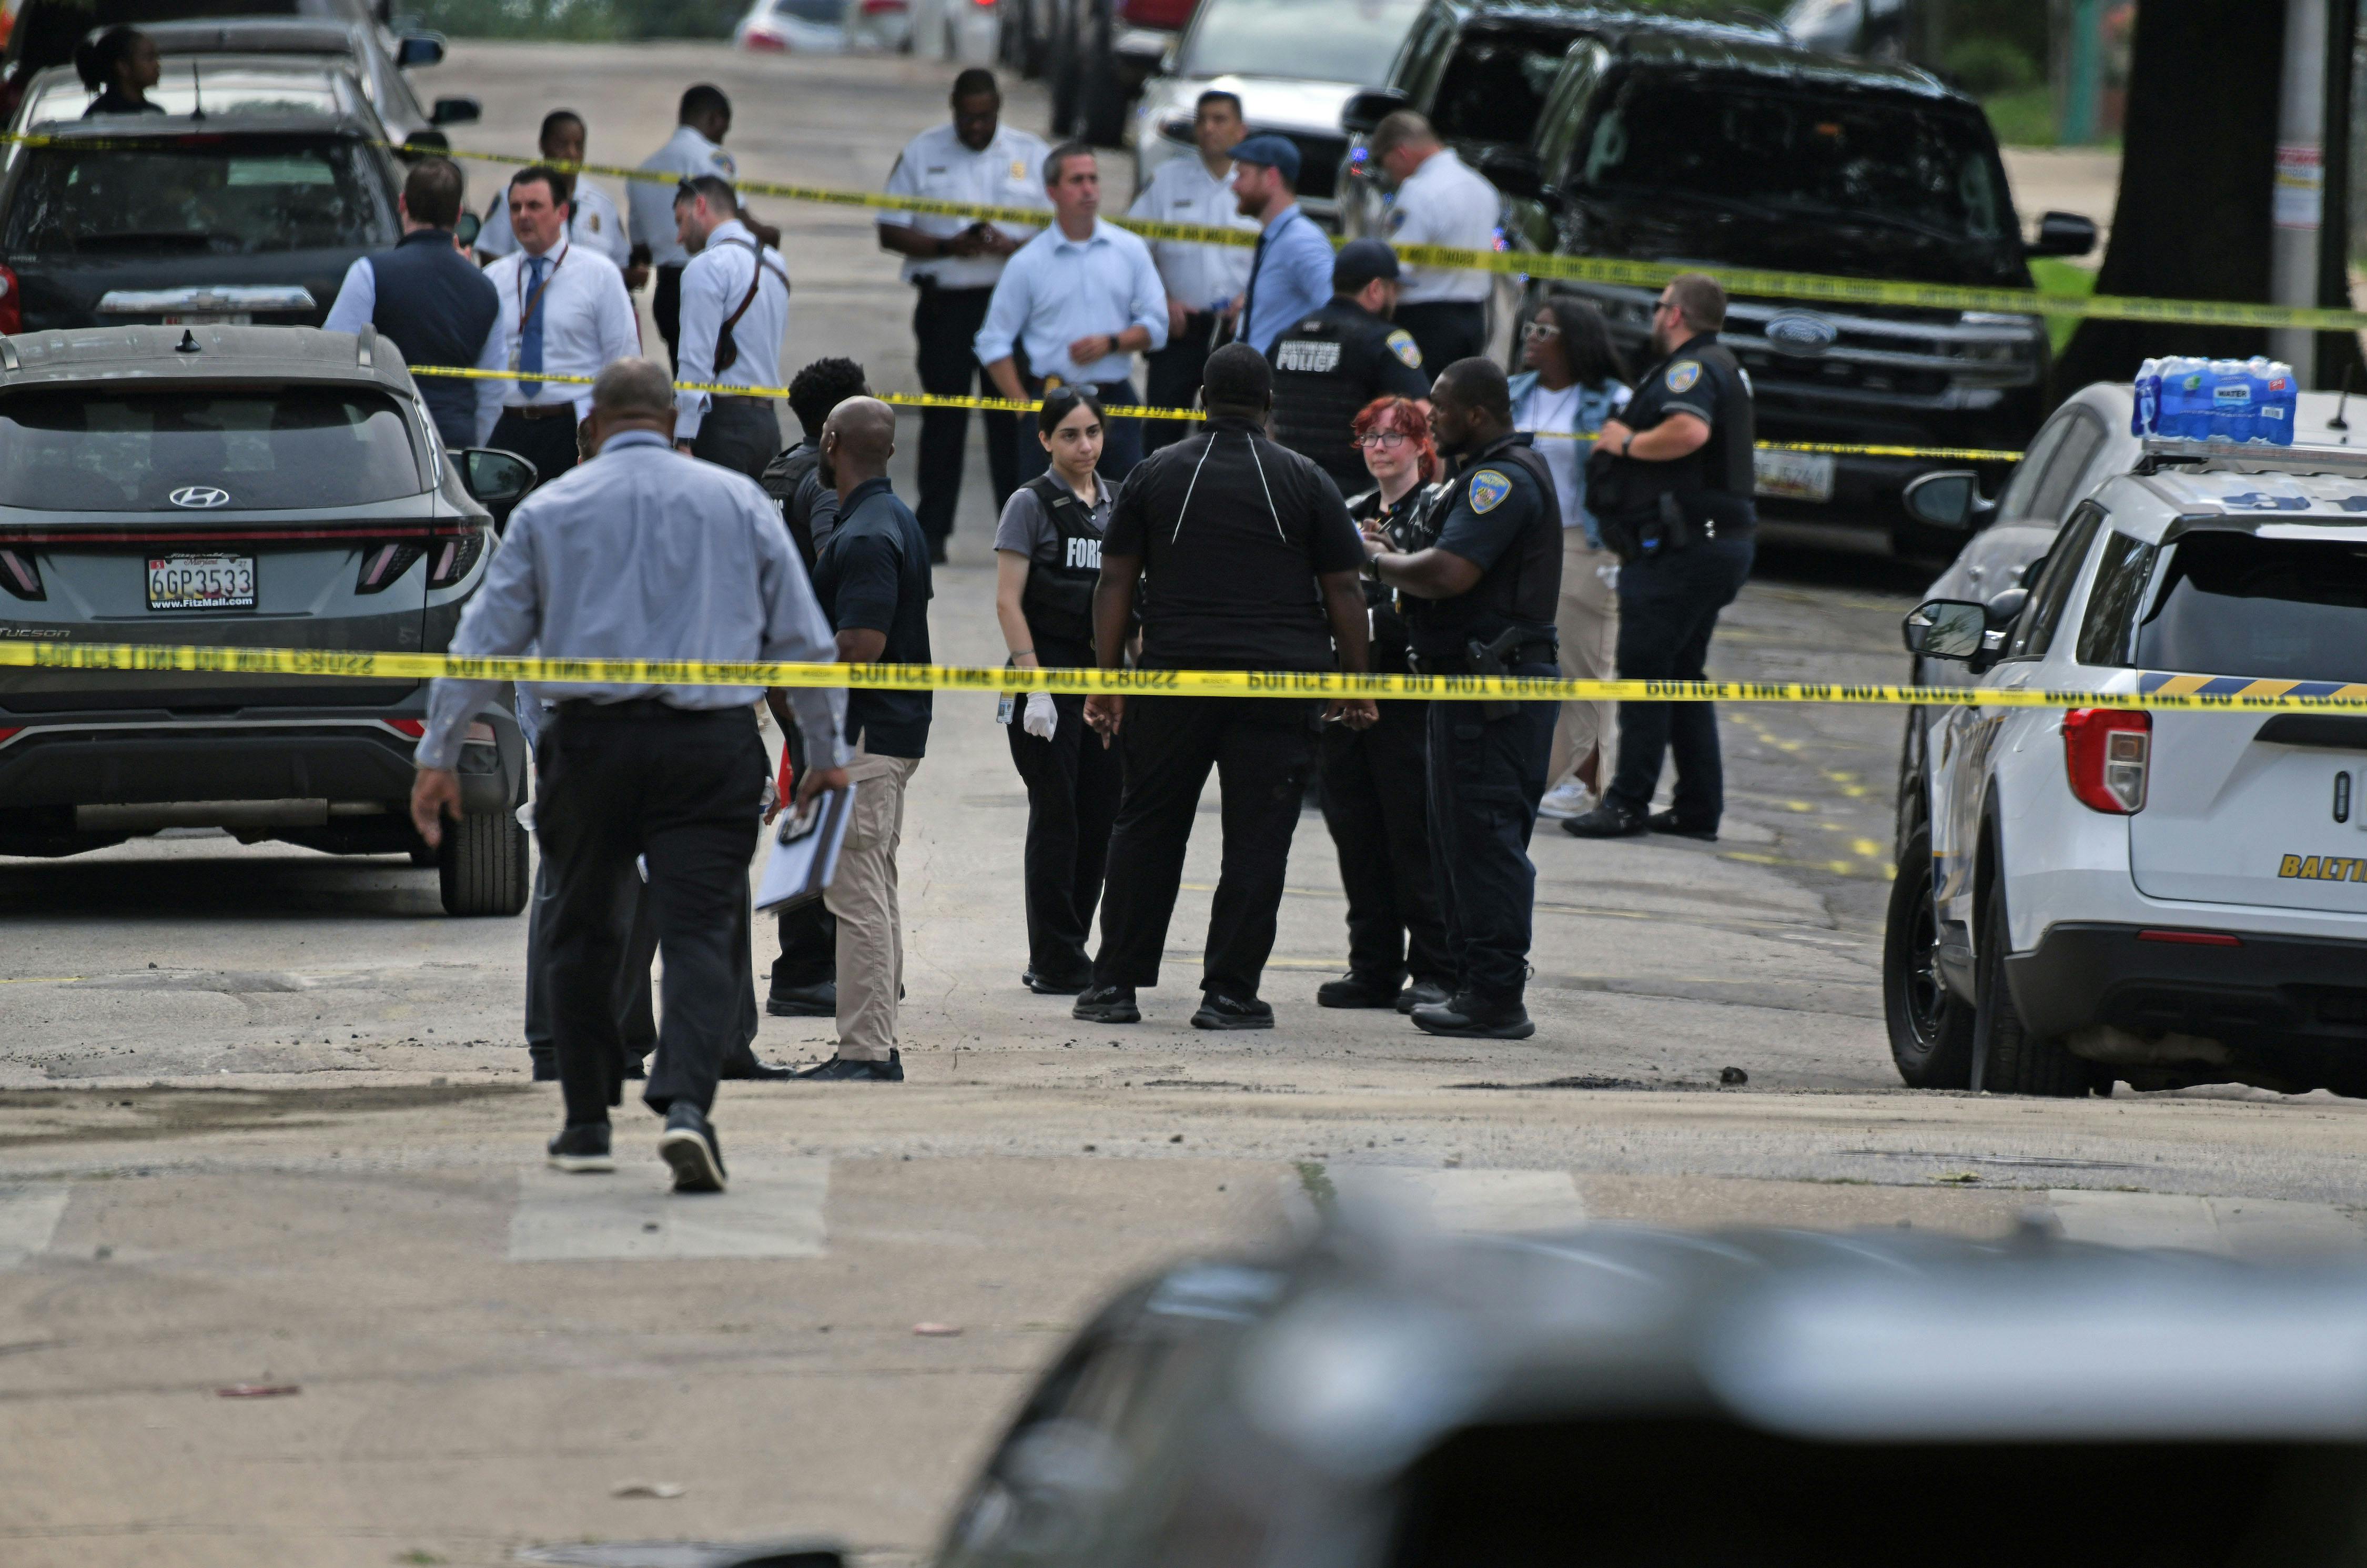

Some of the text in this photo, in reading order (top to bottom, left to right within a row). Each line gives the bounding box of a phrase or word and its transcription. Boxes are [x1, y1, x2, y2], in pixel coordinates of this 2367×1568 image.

[152, 570, 250, 594] 6GP3533
[151, 598, 252, 609] www.FitzMall.com
[2278, 853, 2367, 883] BALTI
